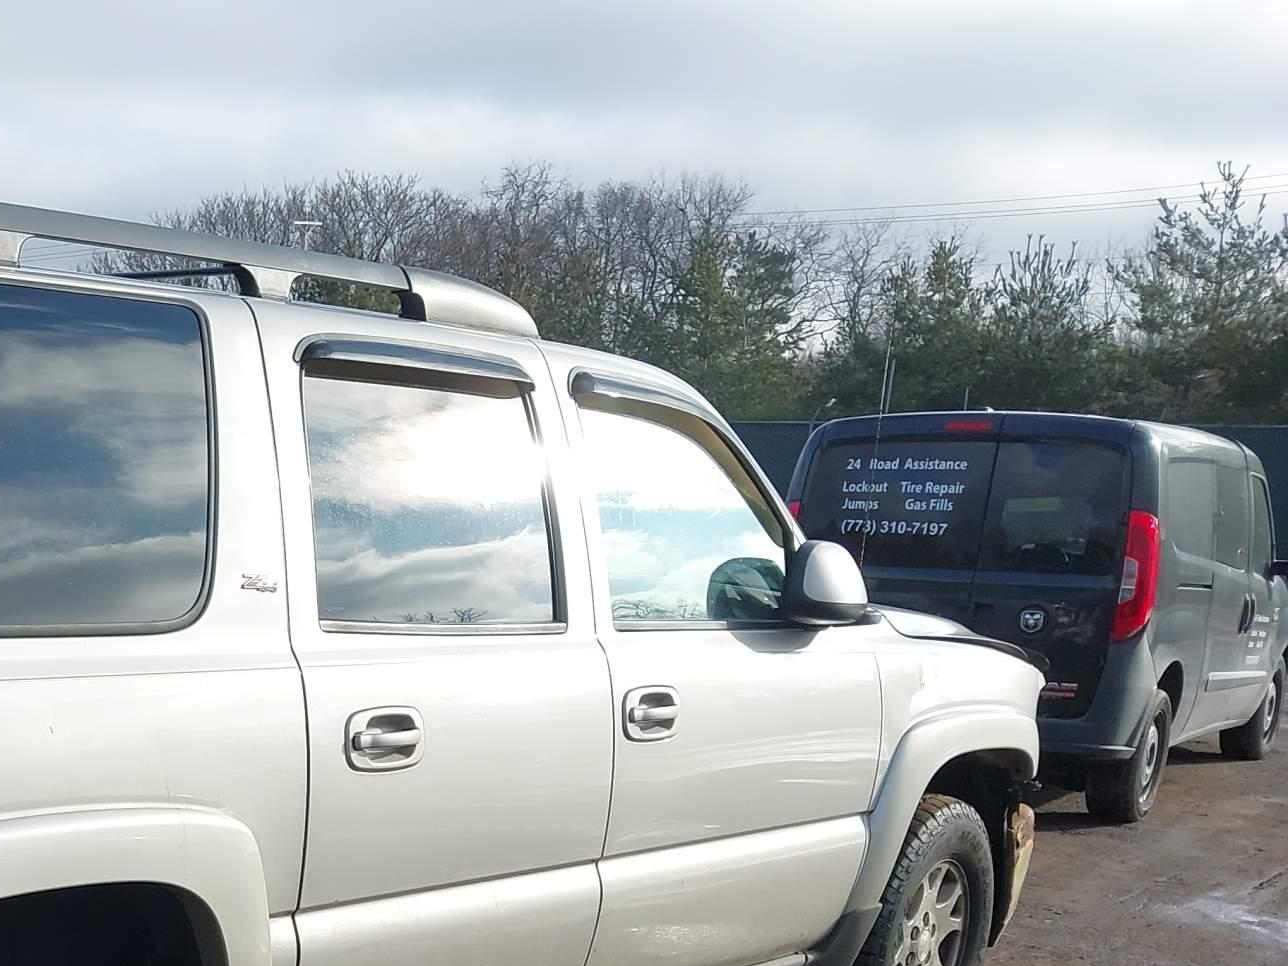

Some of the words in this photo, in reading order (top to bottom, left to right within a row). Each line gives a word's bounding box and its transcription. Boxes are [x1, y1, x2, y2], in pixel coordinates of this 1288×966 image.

[846, 458, 861, 470] 24
[869, 457, 900, 470] Road
[903, 458, 968, 470] Assistance
[842, 480, 888, 493] Lockout
[900, 481, 923, 493] Tire
[925, 482, 965, 496] Repair
[841, 498, 879, 512] Jumps
[905, 498, 927, 511] Gas
[929, 499, 954, 511] Fills
[841, 519, 876, 536] (773)
[879, 520, 948, 536] 310-7197
